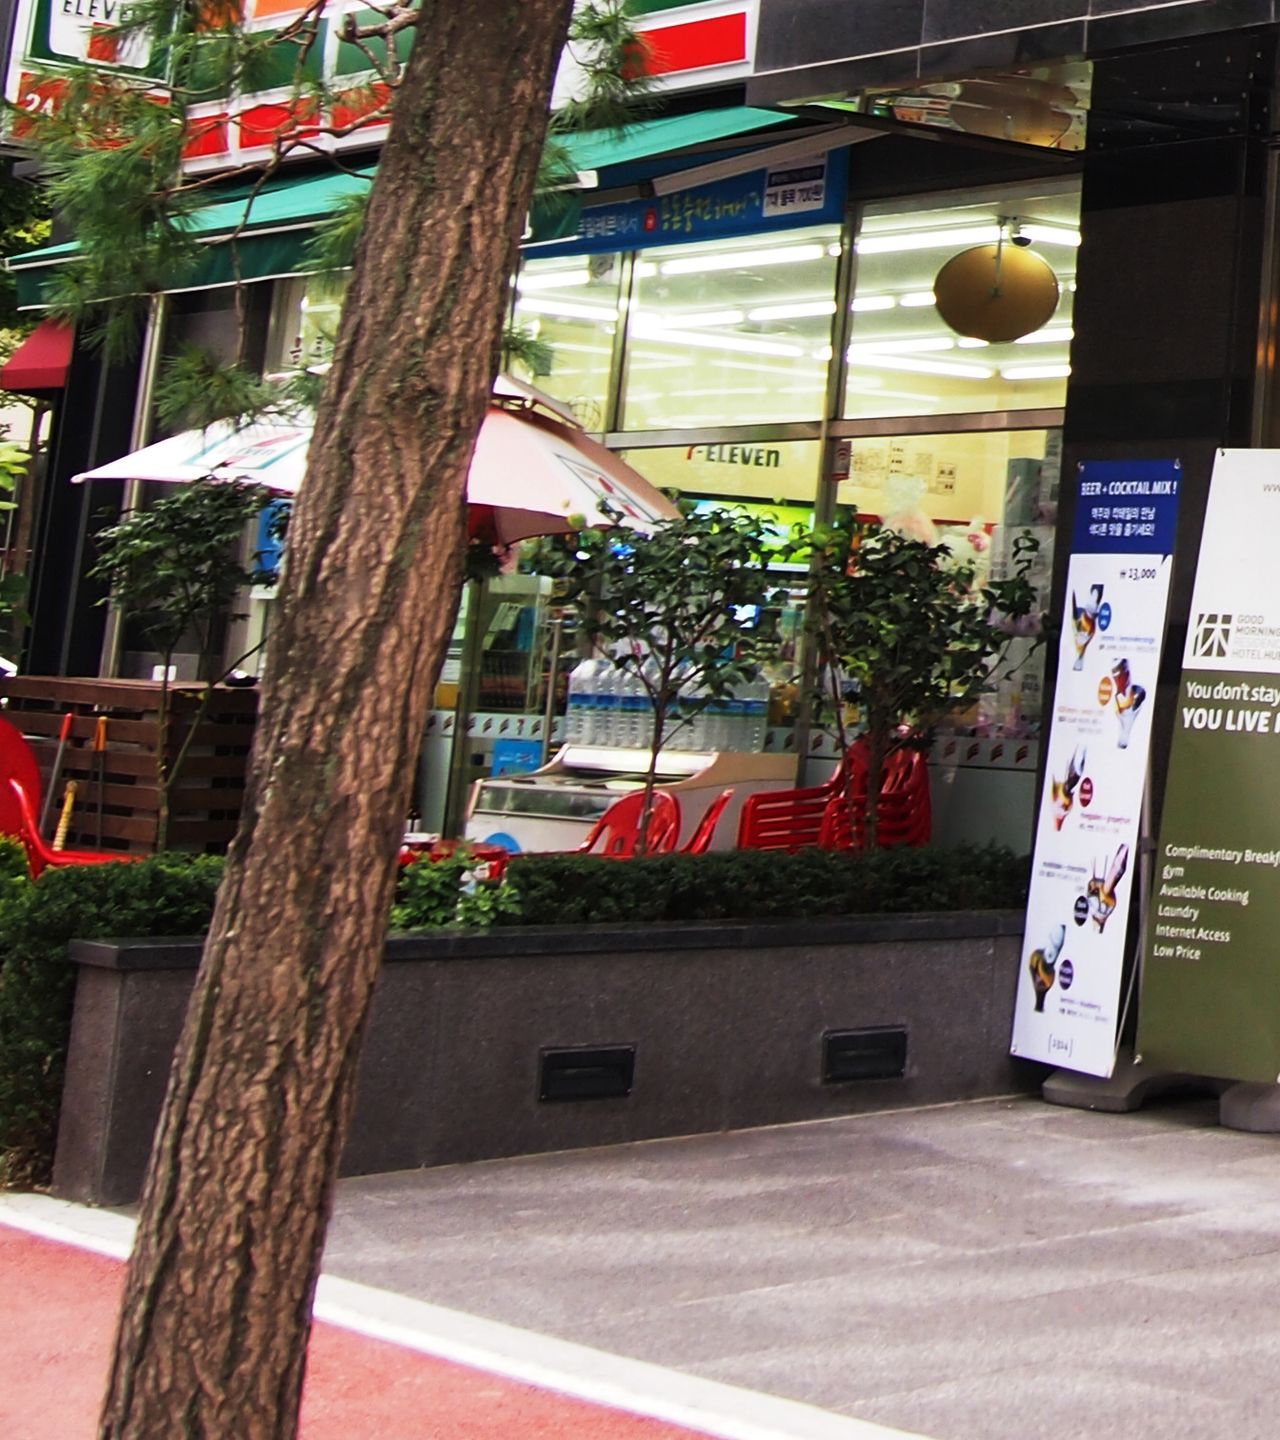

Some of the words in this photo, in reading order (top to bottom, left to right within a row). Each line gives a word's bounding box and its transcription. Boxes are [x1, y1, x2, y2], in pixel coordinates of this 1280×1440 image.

[1081, 482, 1101, 495] BEER
[1109, 481, 1150, 495] COCKTAIL
[1237, 615, 1265, 625] GOOD
[1186, 682, 1211, 700] You
[1212, 682, 1249, 701] don't
[1182, 708, 1223, 731] YOU
[1225, 710, 1271, 733] LIVE
[1165, 844, 1243, 864] Complimentary
[1162, 864, 1185, 880] gym
[1159, 884, 1207, 900] Available
[1207, 887, 1249, 906] Cooking
[1158, 904, 1199, 922] Laundry
[1155, 924, 1196, 939] Internet
[1196, 928, 1231, 942] Access
[1153, 944, 1174, 957] Low
[1175, 946, 1201, 960] Price
